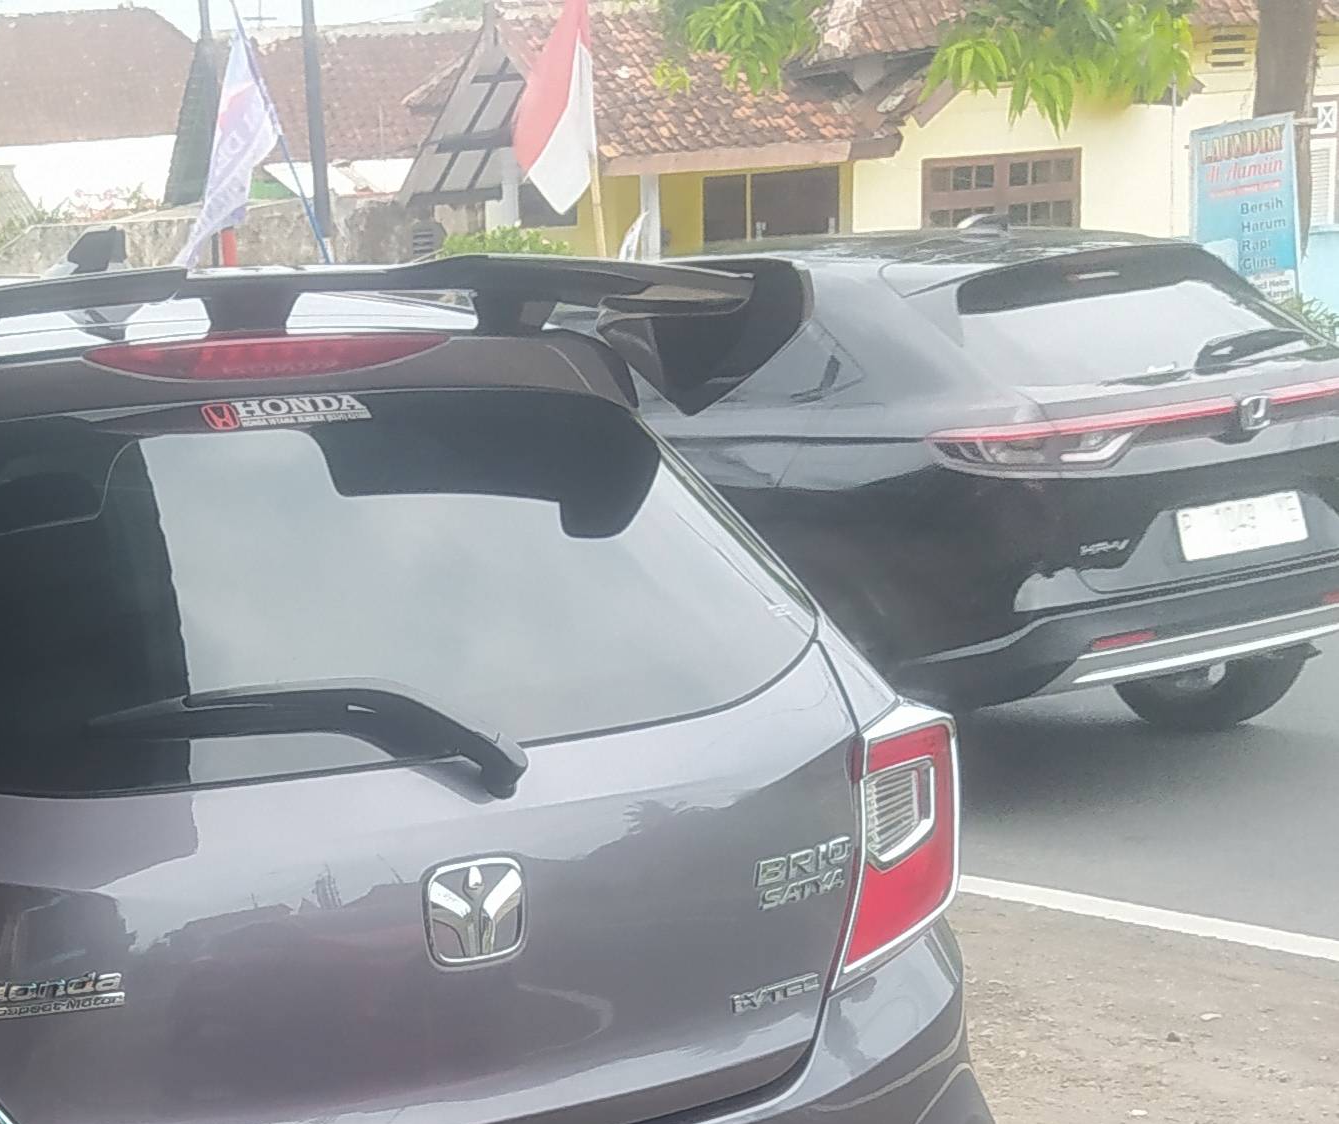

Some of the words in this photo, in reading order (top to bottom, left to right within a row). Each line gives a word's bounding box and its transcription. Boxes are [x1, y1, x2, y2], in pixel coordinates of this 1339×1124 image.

[1200, 125, 1284, 163] LAUNDRY
[1240, 197, 1283, 215] Bersih
[1241, 217, 1286, 233] Harum
[232, 395, 367, 418] HONDA
[755, 836, 851, 887] BRIO
[760, 868, 845, 911] SATYA
